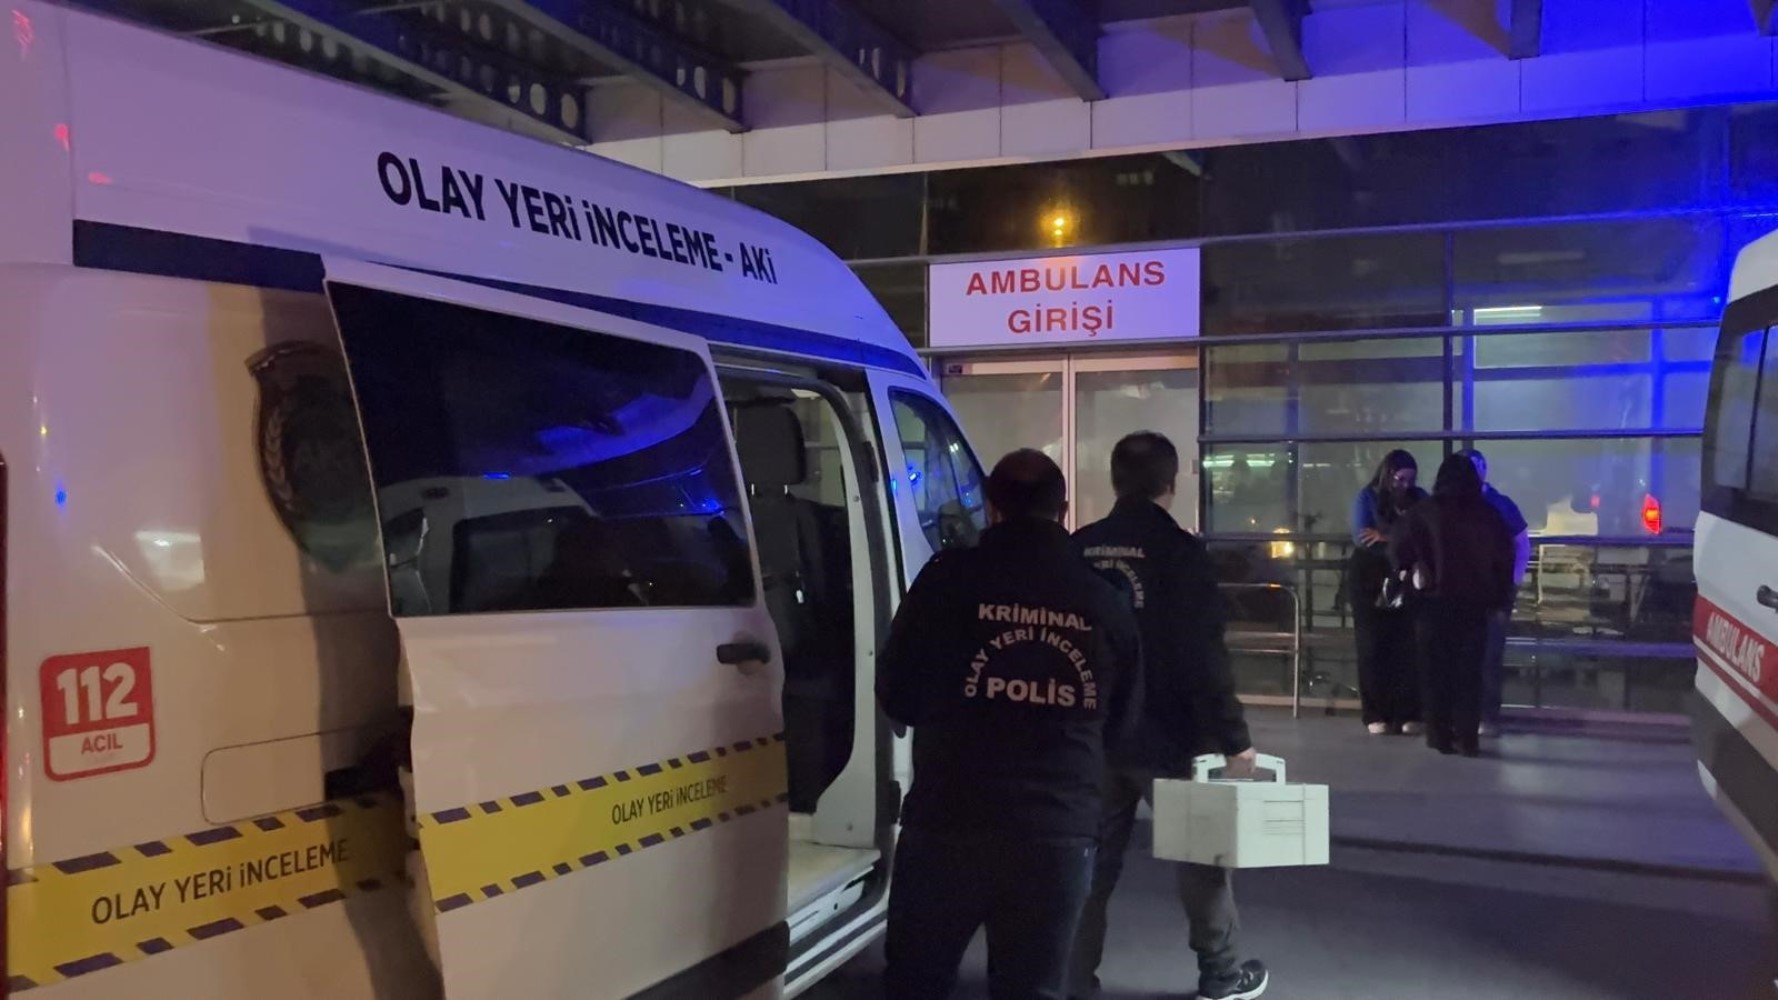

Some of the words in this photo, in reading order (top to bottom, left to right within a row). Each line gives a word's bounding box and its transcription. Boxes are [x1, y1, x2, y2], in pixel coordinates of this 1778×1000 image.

[377, 151, 485, 221] OLAY
[966, 261, 1165, 295] AMBULANS
[1008, 299, 1113, 337] GİRİŞİ
[978, 603, 1092, 631] KRİMİNAL
[1706, 611, 1765, 682] AMBULANS
[965, 647, 989, 697] OLAY
[990, 627, 1034, 650] YERİ
[1040, 627, 1097, 710] İNCELEME
[57, 662, 137, 725] 112
[986, 677, 1076, 707] POLİS
[612, 799, 644, 825] OLAY
[91, 882, 166, 924] OLAY
